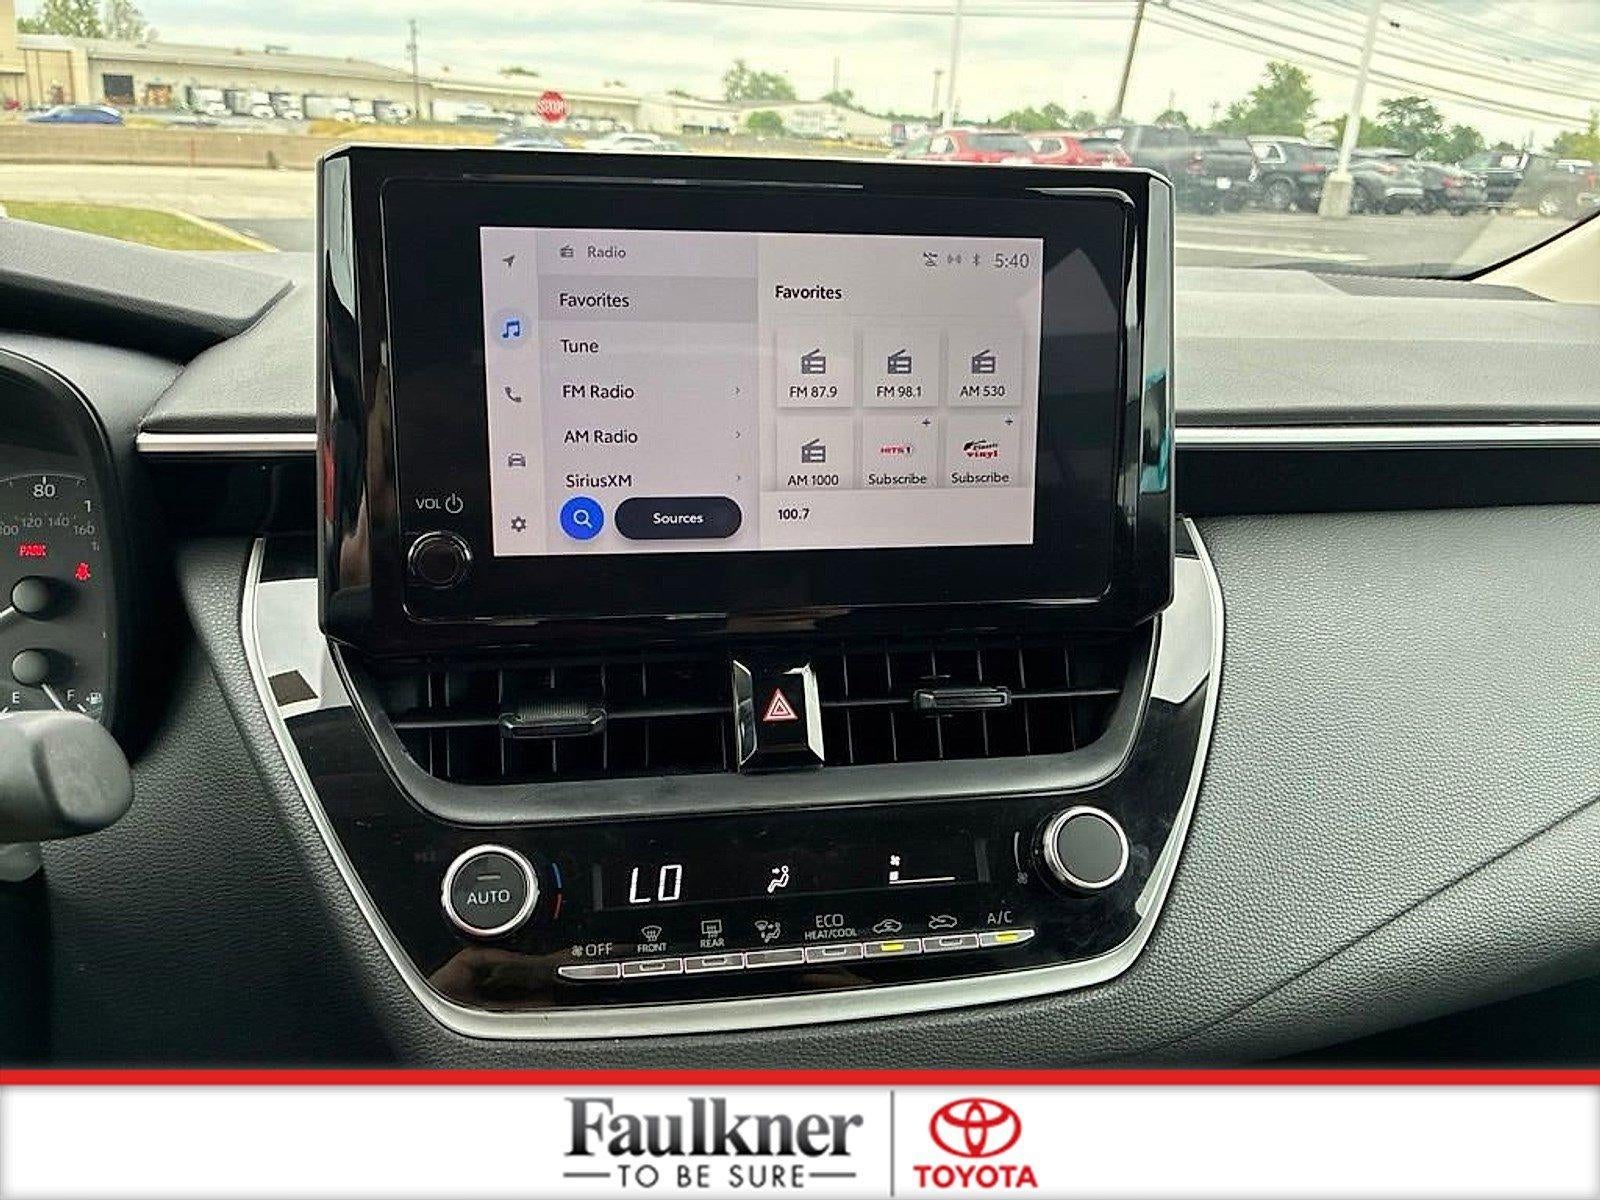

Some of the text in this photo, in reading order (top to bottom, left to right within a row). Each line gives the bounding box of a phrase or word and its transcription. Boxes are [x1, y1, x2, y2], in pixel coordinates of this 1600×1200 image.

[587, 246, 627, 259] Radio
[994, 253, 1030, 269] 5:40
[775, 285, 843, 301] Favorites
[559, 292, 630, 308] Favorites
[560, 339, 599, 354] Tune
[562, 384, 635, 400] FM Radio
[789, 386, 838, 399] FM 87.9
[876, 386, 922, 398] FM 98.1
[960, 386, 1006, 398] AM 530
[563, 429, 638, 445] AM Radio
[566, 473, 633, 489] SiriusXM
[788, 474, 840, 486] AM 1000
[868, 473, 928, 486] Subscribe
[951, 472, 1010, 485] Subscribe
[33, 484, 56, 498] 80
[415, 498, 441, 510] VOL
[652, 511, 704, 526] Sources
[777, 508, 810, 521] 100.7
[22, 517, 42, 528] 120
[48, 517, 70, 527] 140
[73, 525, 95, 536] 160
[12, 692, 20, 704] E
[67, 689, 75, 701] F
[467, 889, 511, 905] AUTO
[815, 914, 844, 928] ECO
[987, 910, 1013, 926] A/C
[804, 928, 857, 940] HEAT/COOL
[585, 943, 613, 956] OFF
[637, 943, 667, 953] FRONT
[700, 938, 725, 948] REAR
